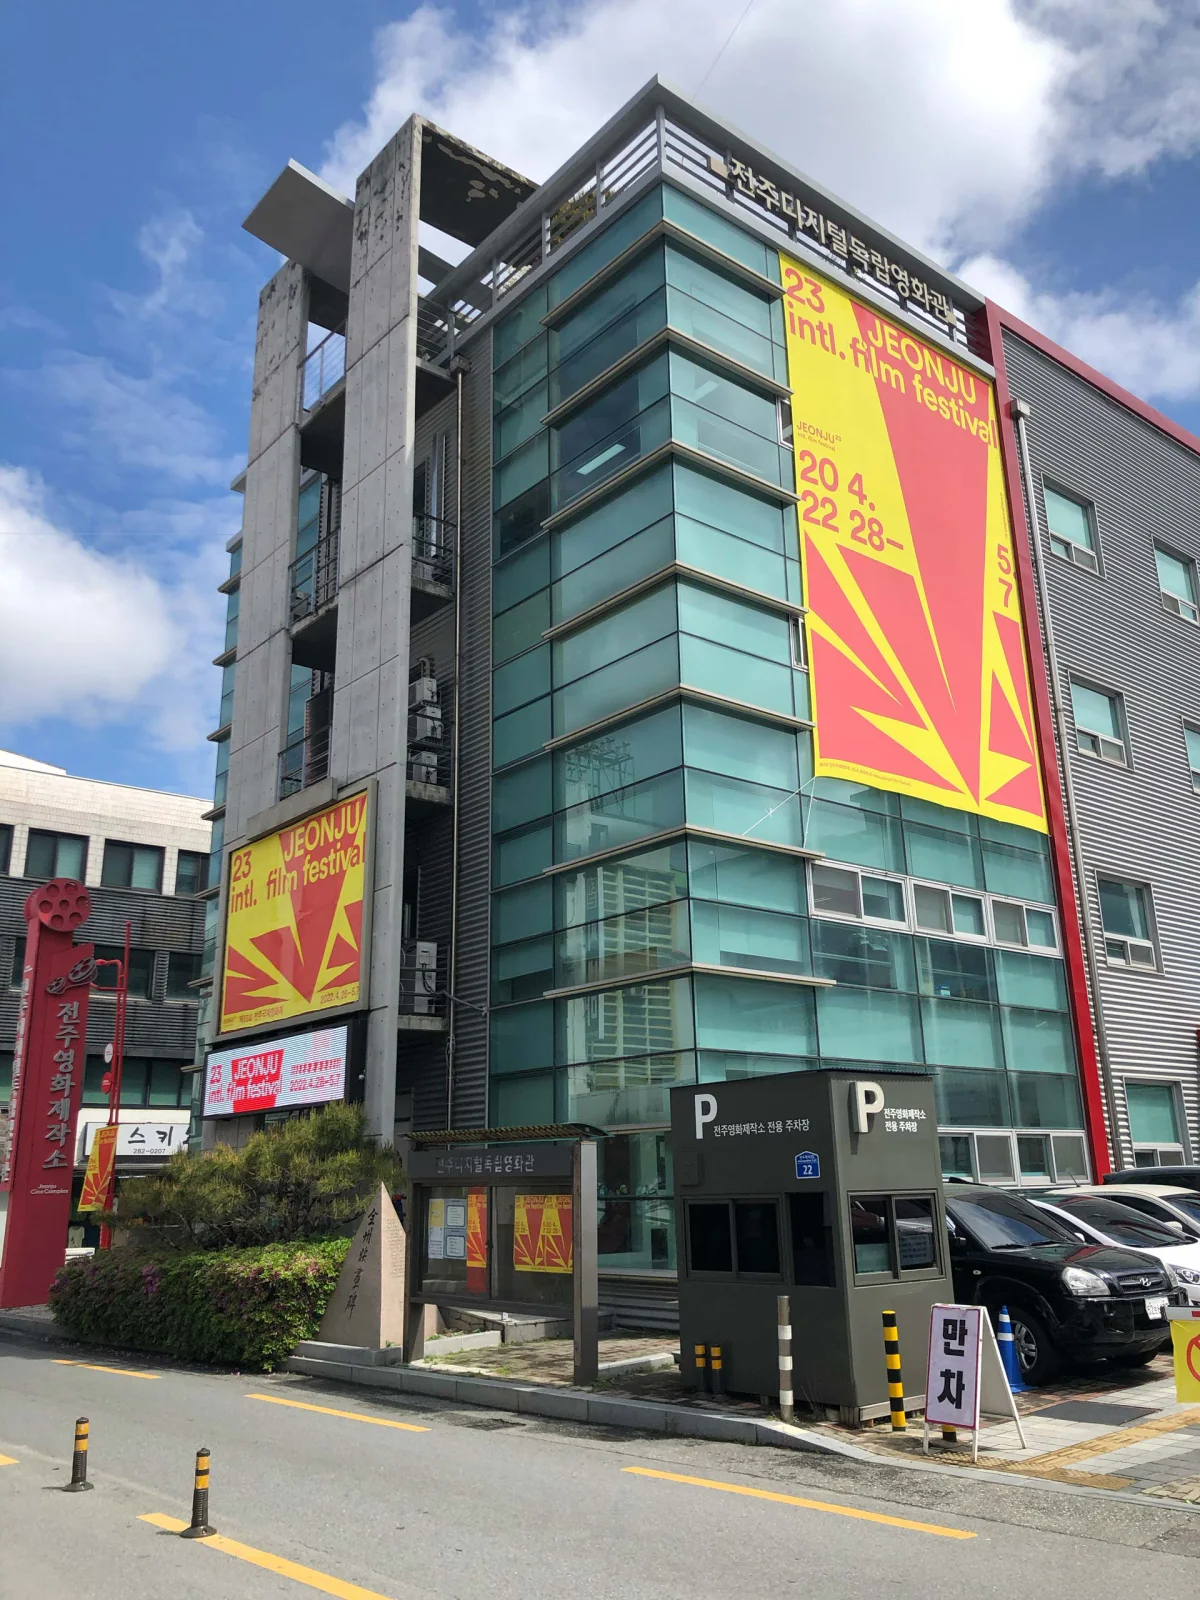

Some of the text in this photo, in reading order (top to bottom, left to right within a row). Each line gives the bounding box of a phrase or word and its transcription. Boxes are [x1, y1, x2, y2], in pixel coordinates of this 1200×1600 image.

[731, 158, 949, 320] 전주디지털독립영화관
[785, 267, 976, 405] 23 JEONJU
[787, 300, 998, 449] intl. film festival
[799, 449, 876, 511] 20 4.
[801, 489, 840, 533] 22
[999, 577, 1013, 608] 7
[232, 801, 361, 882] 23 JEONJU
[230, 832, 366, 913] intl. film festival
[42, 1002, 81, 1169] 전주영화제작소
[209, 1065, 223, 1084] 23
[233, 1053, 279, 1081] JEONJU
[248, 1074, 283, 1099] festival
[694, 1093, 718, 1140] P
[713, 1118, 810, 1137] 전주영화제작소 전용 주차장
[855, 1081, 885, 1133] P
[883, 1108, 927, 1120] 전주영화제작소
[884, 1121, 918, 1133] 전용 주차장
[803, 1164, 813, 1175] 22
[937, 1318, 968, 1410] 만차
